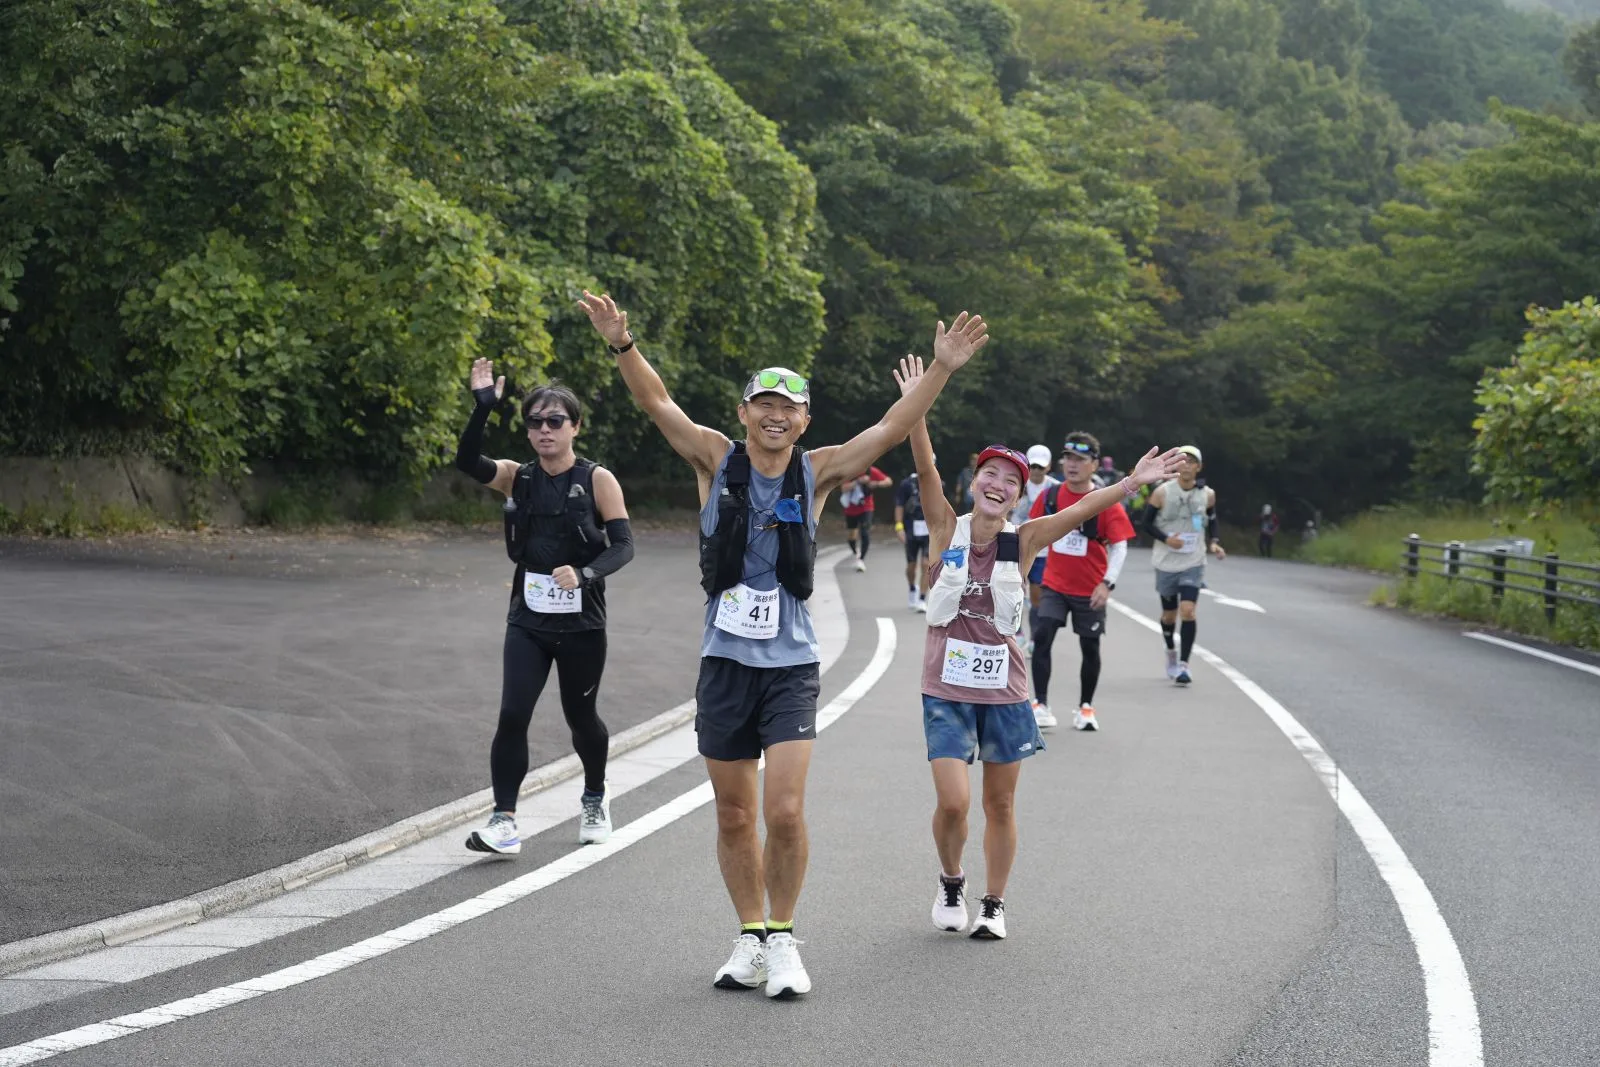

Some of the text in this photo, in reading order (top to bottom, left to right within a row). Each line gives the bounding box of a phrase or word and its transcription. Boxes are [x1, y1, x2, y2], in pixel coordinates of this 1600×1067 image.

[547, 587, 575, 600] 478
[749, 605, 770, 622] 41
[971, 657, 1004, 674] 297
